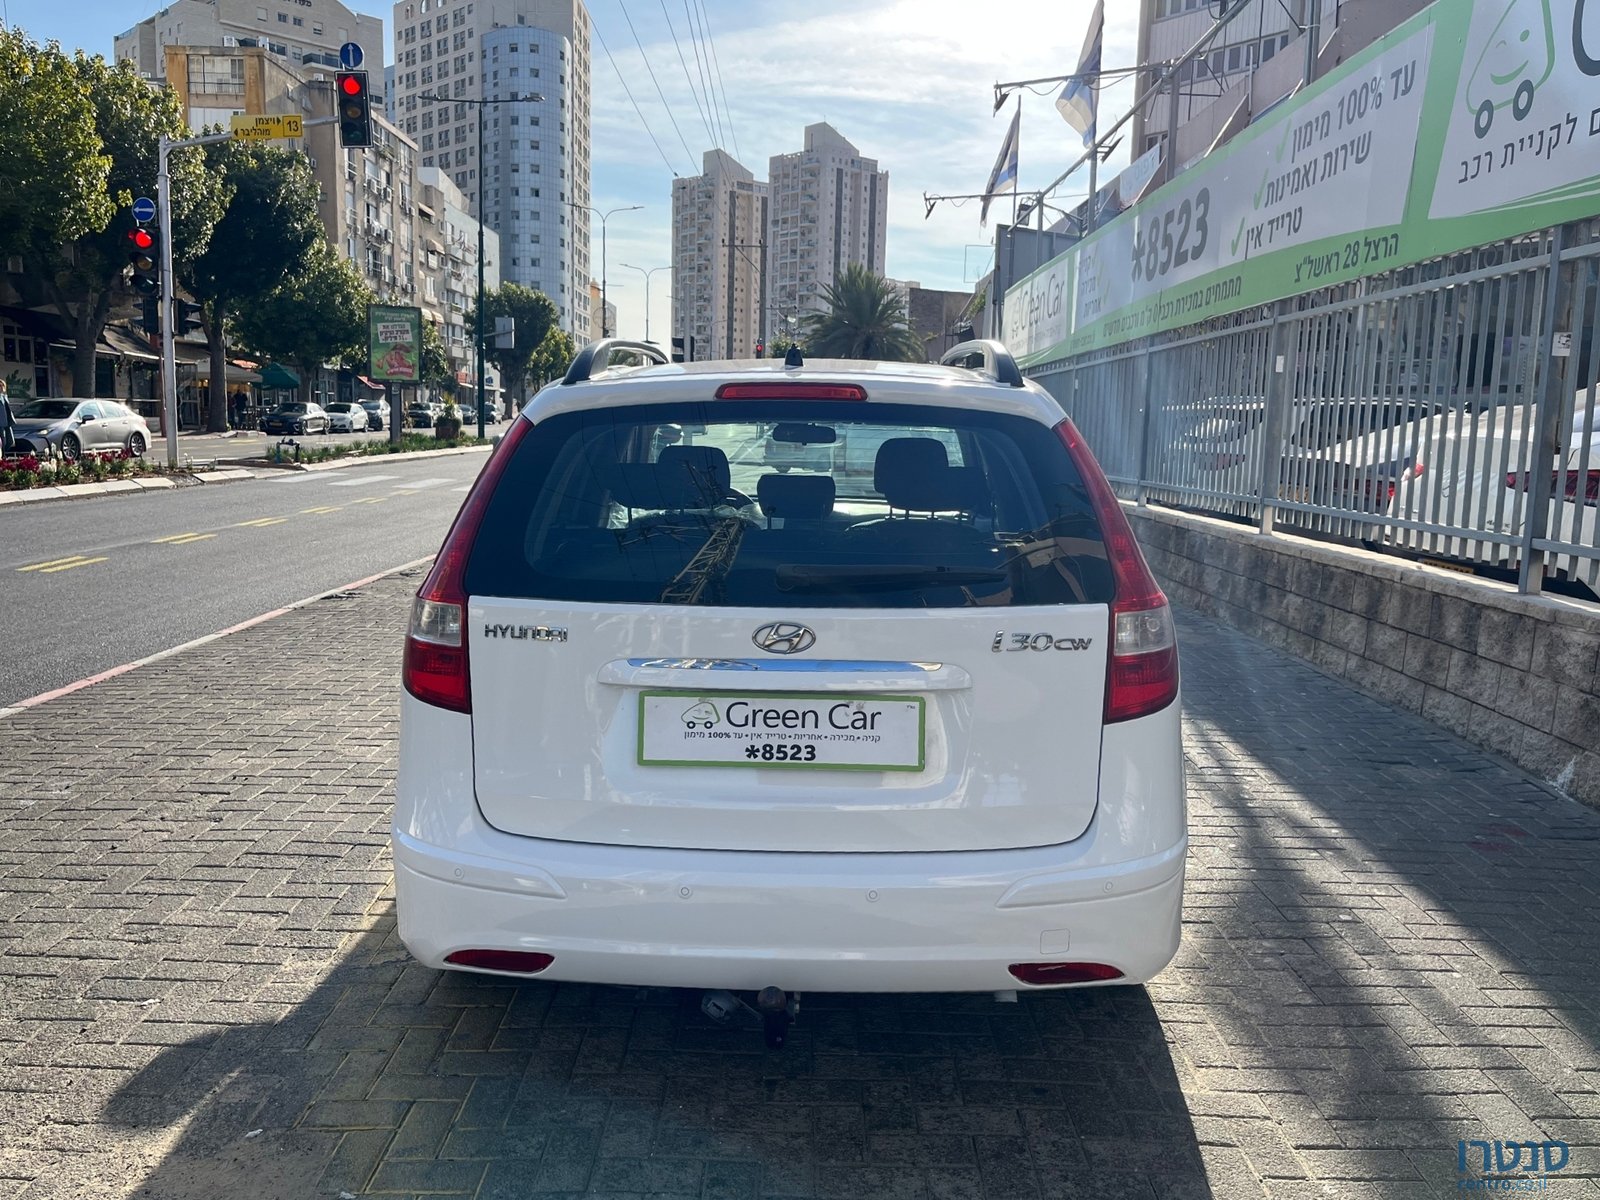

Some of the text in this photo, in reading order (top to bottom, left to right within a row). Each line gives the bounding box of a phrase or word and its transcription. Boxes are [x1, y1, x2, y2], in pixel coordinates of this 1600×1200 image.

[255, 117, 275, 127] ויצמן
[286, 120, 299, 132] 13
[1291, 60, 1416, 164] עד 100% מימון
[1500, 112, 1578, 169] לקניית
[1264, 130, 1372, 208] שירות ואמינות
[1458, 150, 1493, 184] רכב
[1244, 206, 1303, 261] טרייד אין
[1294, 233, 1399, 284] הרצל 28 ראשל"צ
[1047, 273, 1065, 319] Car
[1205, 275, 1242, 306] מתמחים
[484, 623, 568, 642] HYUNDAI
[725, 701, 882, 730] Green Car
[684, 731, 881, 743] קניה מכירה אחריות טרייד אין עד 100% מימון
